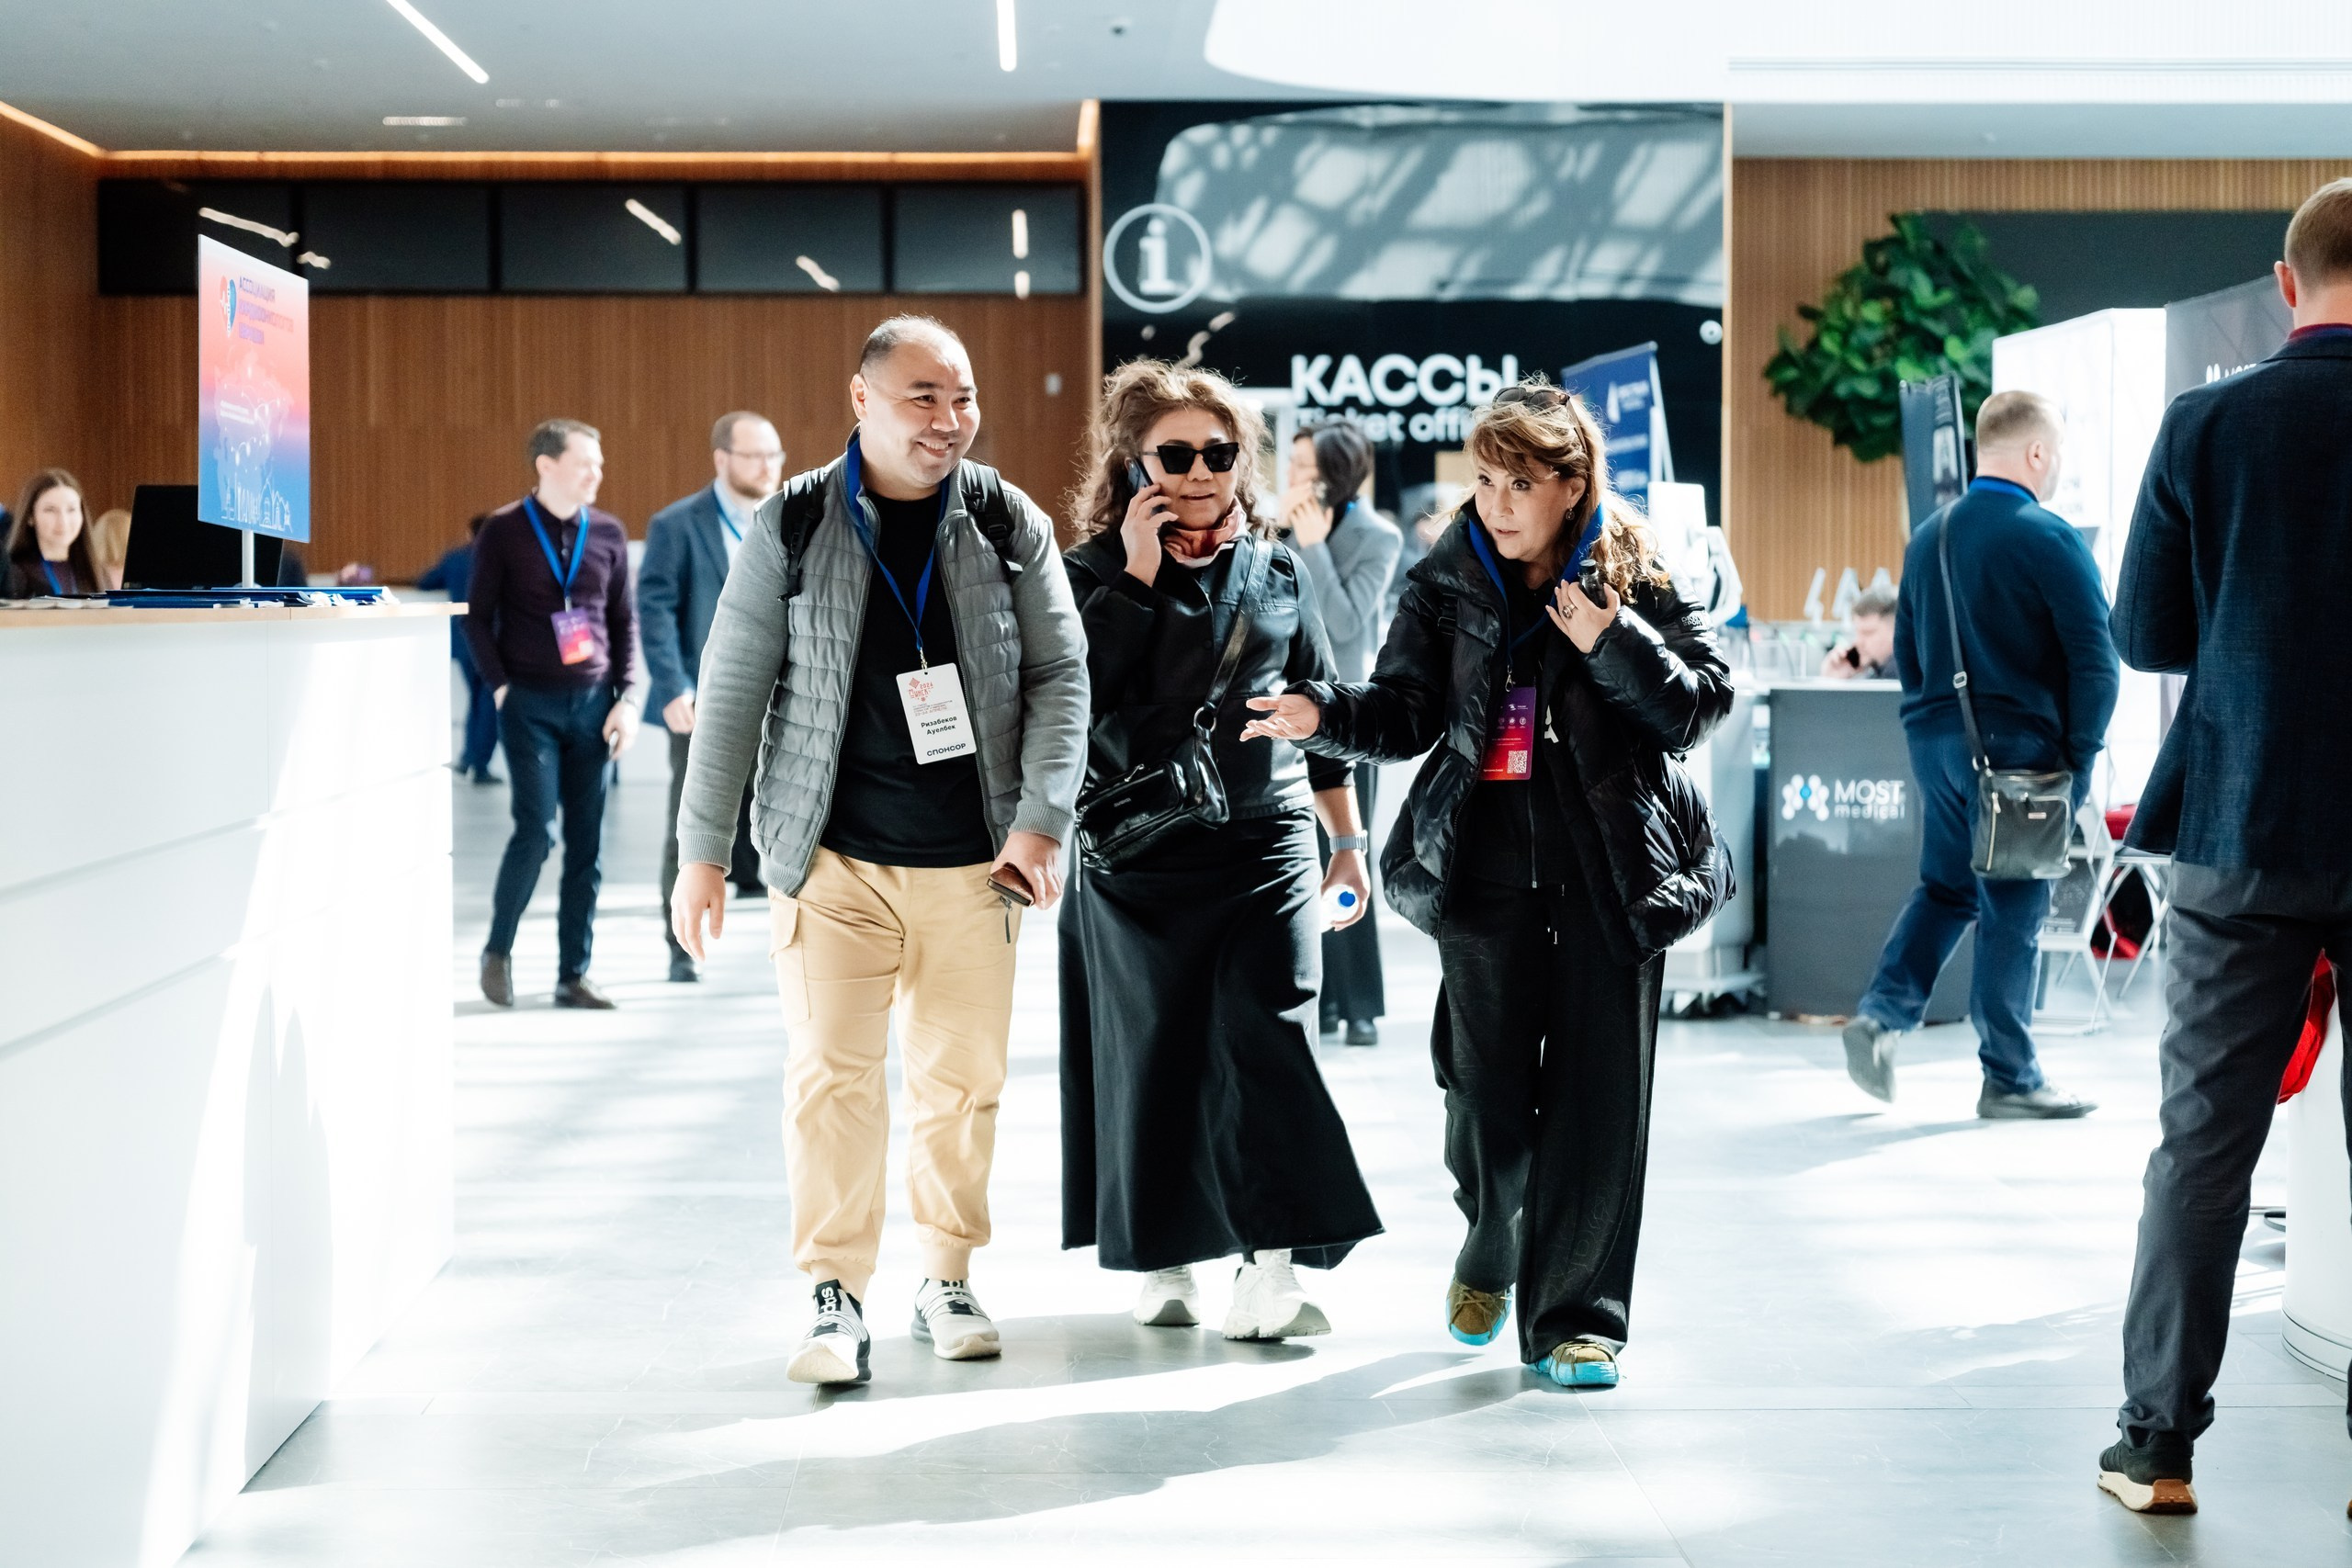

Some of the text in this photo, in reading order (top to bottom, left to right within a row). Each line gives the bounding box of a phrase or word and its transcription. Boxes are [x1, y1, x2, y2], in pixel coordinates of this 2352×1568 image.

[1291, 354, 1518, 407] КАССЫ
[1408, 406, 1474, 442] offi
[921, 716, 957, 728] Ризабеков
[926, 725, 956, 735] Ауелбек
[926, 743, 967, 756] СПОНСОР
[1834, 779, 1905, 805] MOST
